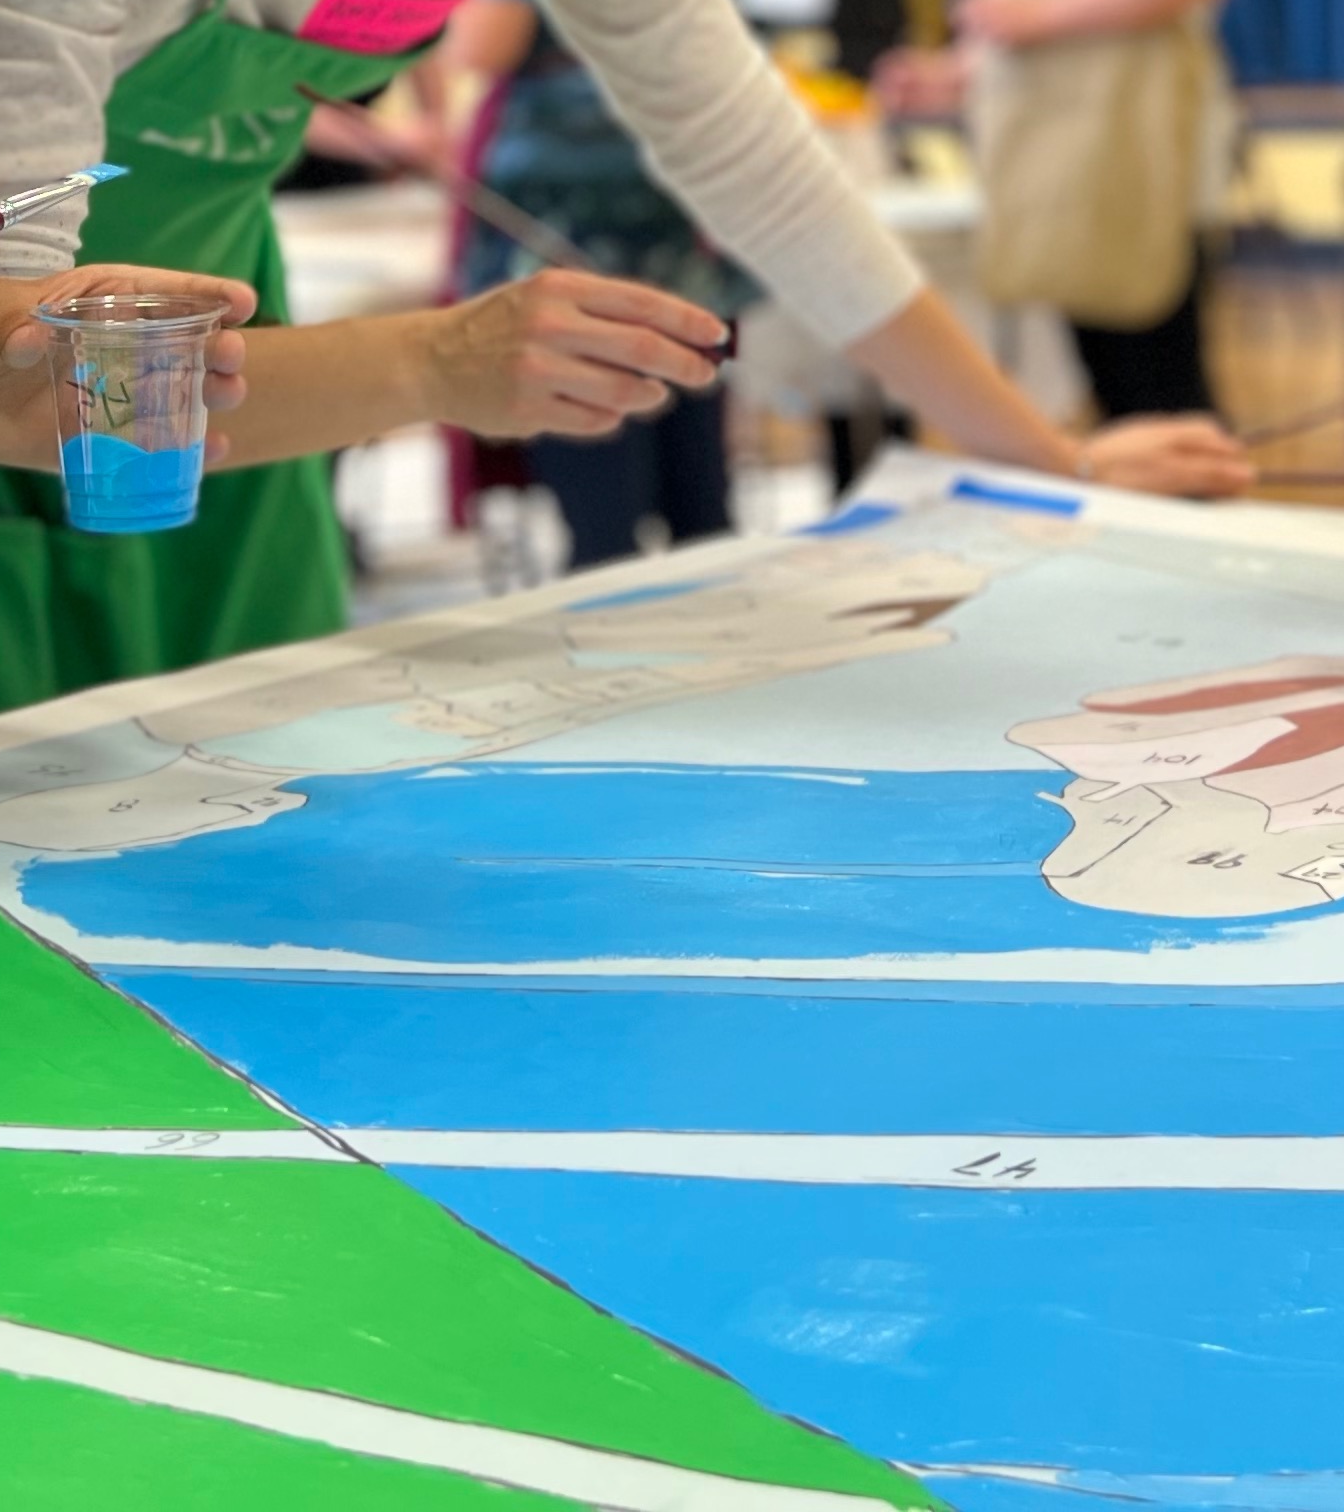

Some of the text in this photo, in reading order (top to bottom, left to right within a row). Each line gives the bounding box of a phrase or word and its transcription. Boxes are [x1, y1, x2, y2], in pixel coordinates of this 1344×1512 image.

[1142, 752, 1203, 766] 104
[1102, 814, 1136, 827] 14
[952, 1152, 1037, 1179] 47
